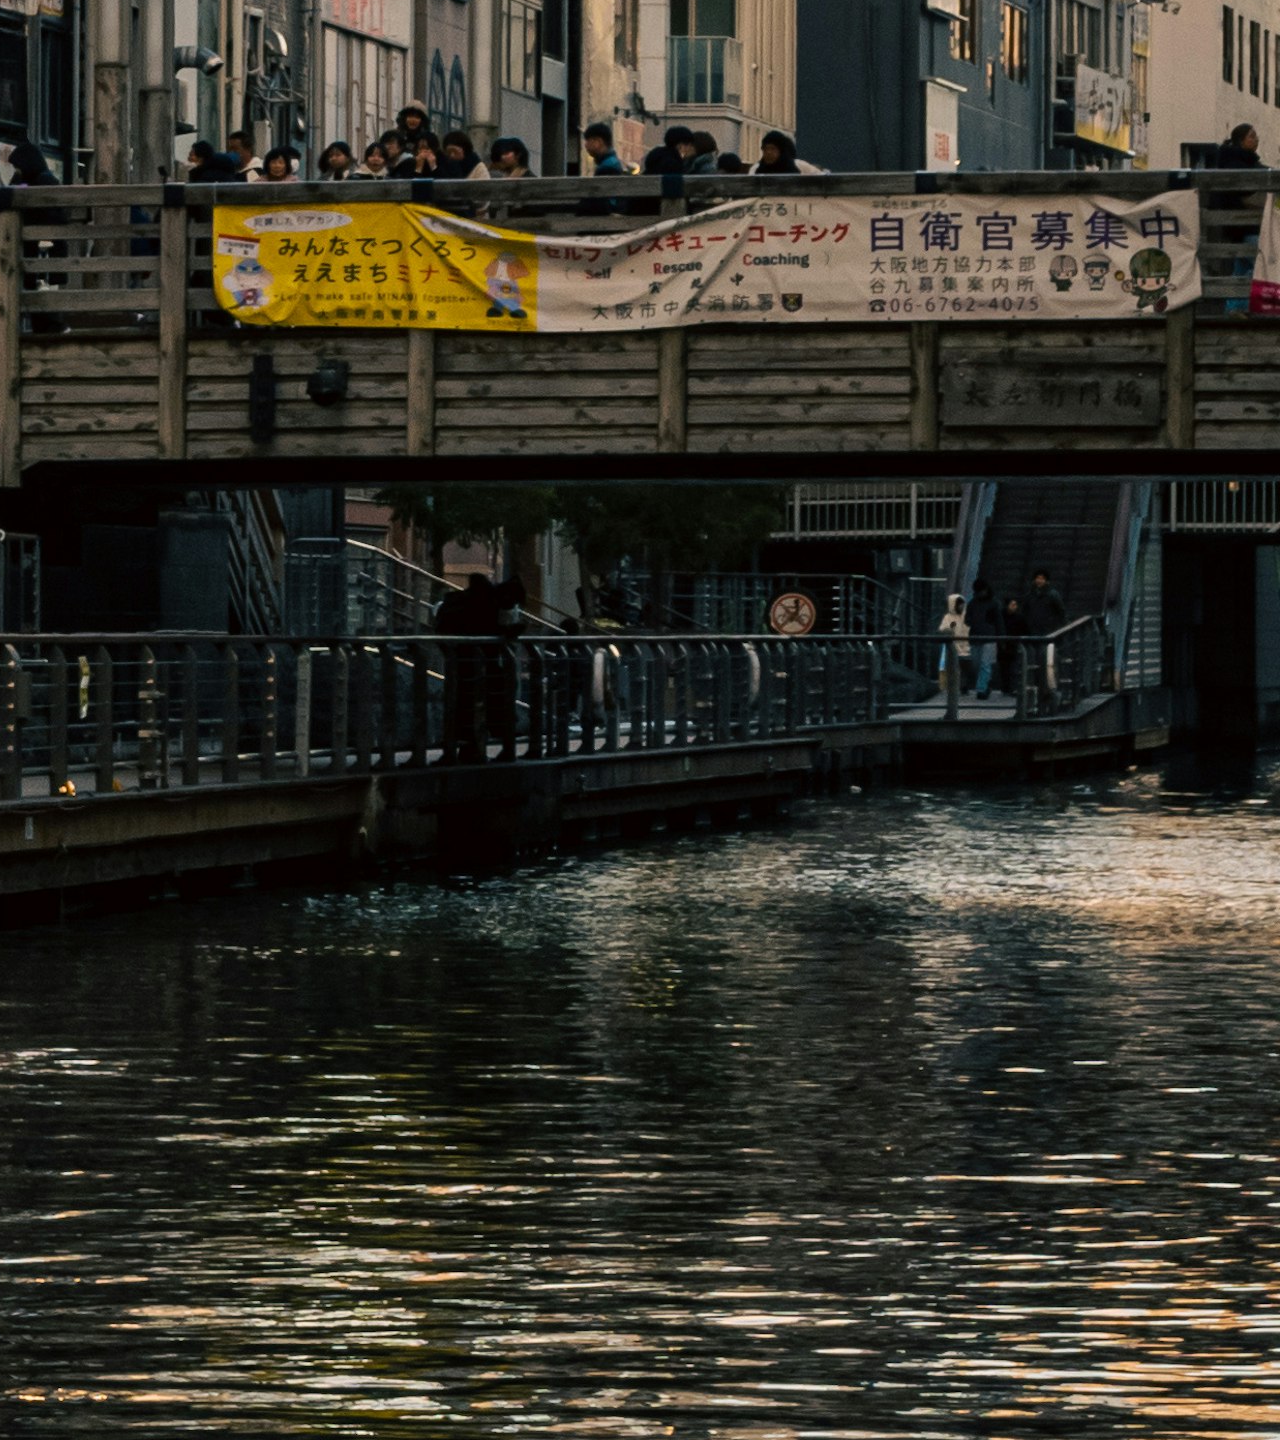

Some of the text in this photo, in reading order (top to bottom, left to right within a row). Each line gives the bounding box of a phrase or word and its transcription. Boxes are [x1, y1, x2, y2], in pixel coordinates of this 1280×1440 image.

[870, 209, 1181, 252] 自衛官募集中
[278, 237, 479, 261] みんなでつくろう
[293, 263, 465, 285] ええまちミナミ
[586, 253, 810, 280] Self Rescue Coaching
[869, 256, 1037, 275] 大阪地方協力本部
[869, 276, 1035, 295] 谷九募集案内所
[592, 294, 774, 320] 大阪市中央消防署
[889, 296, 1040, 314] 06-6762-4075
